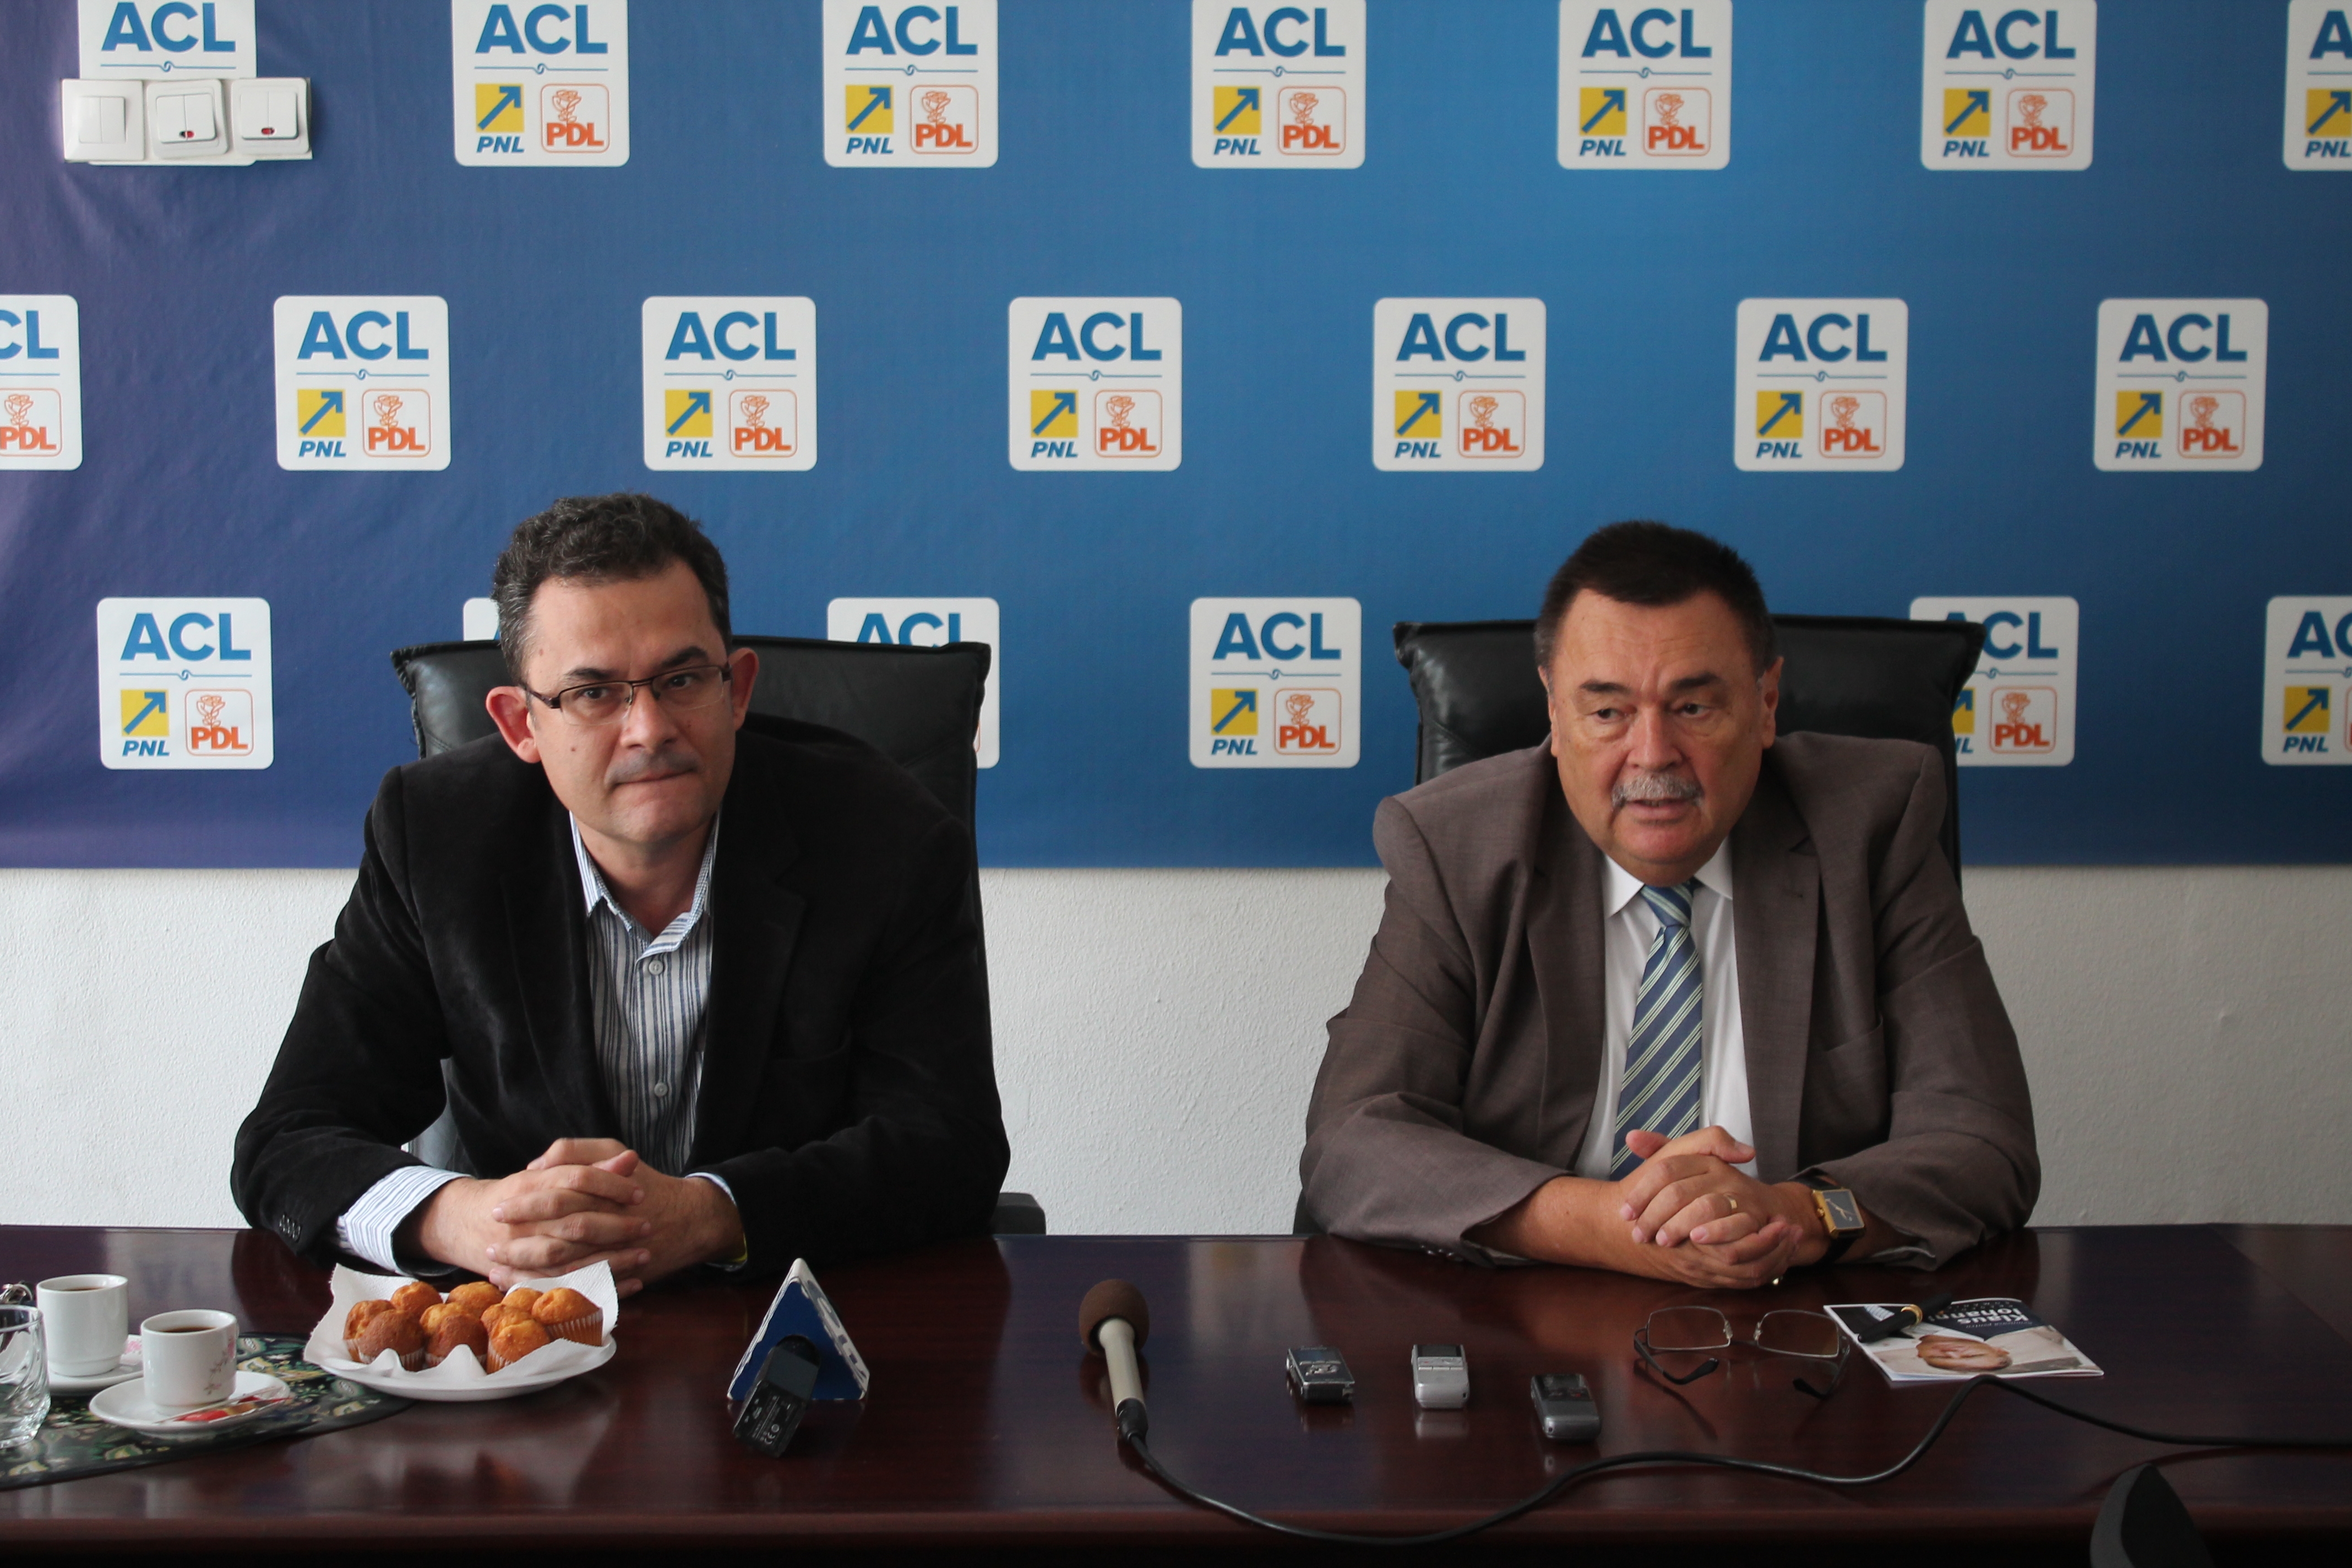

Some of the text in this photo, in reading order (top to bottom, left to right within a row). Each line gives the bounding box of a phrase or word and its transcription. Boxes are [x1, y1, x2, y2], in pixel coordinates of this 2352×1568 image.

[101, 3, 235, 53] ACL
[475, 3, 608, 54] ACL
[846, 5, 977, 56] ACL
[1215, 7, 1346, 57] ACL
[1582, 8, 1712, 58] ACL
[1947, 9, 2076, 59] ACL
[477, 136, 524, 153] PNL
[547, 123, 604, 146] PDL
[846, 137, 893, 154] PNL
[916, 124, 973, 148] PDL
[1283, 125, 1340, 149] PDL
[1648, 126, 1705, 150] PDL
[2011, 127, 2067, 150] PDL
[1215, 138, 1260, 155] PNL
[1580, 139, 1626, 155] PNL
[1944, 140, 1989, 156] PNL
[2306, 141, 2351, 156] PNL
[297, 310, 428, 360] ACL
[665, 311, 796, 361] ACL
[1032, 312, 1162, 361] ACL
[1397, 312, 1526, 362] ACL
[1759, 313, 1887, 362] ACL
[2120, 314, 2247, 362] ACL
[0, 427, 56, 449] PDL
[298, 440, 346, 458] PNL
[368, 427, 426, 450] PDL
[666, 441, 712, 458] PNL
[735, 427, 792, 451] PDL
[1100, 427, 1157, 451] PDL
[1463, 428, 1520, 451] PDL
[1824, 428, 1880, 451] PDL
[2184, 428, 2239, 451] PDL
[1032, 442, 1077, 458] PNL
[1396, 442, 1440, 458] PNL
[1757, 442, 1801, 458] PNL
[2116, 442, 2160, 458] PNL
[120, 612, 251, 662] ACL
[1213, 612, 1341, 660] ACL
[1944, 612, 2058, 659] CL
[192, 727, 248, 749] PDL
[1280, 725, 1336, 749] PDL
[1996, 723, 2050, 747] PDL
[2283, 736, 2329, 753] PNL
[122, 740, 170, 756] PNL
[1212, 739, 1256, 755] PNL
[1957, 1314, 2029, 1324] Klaus
